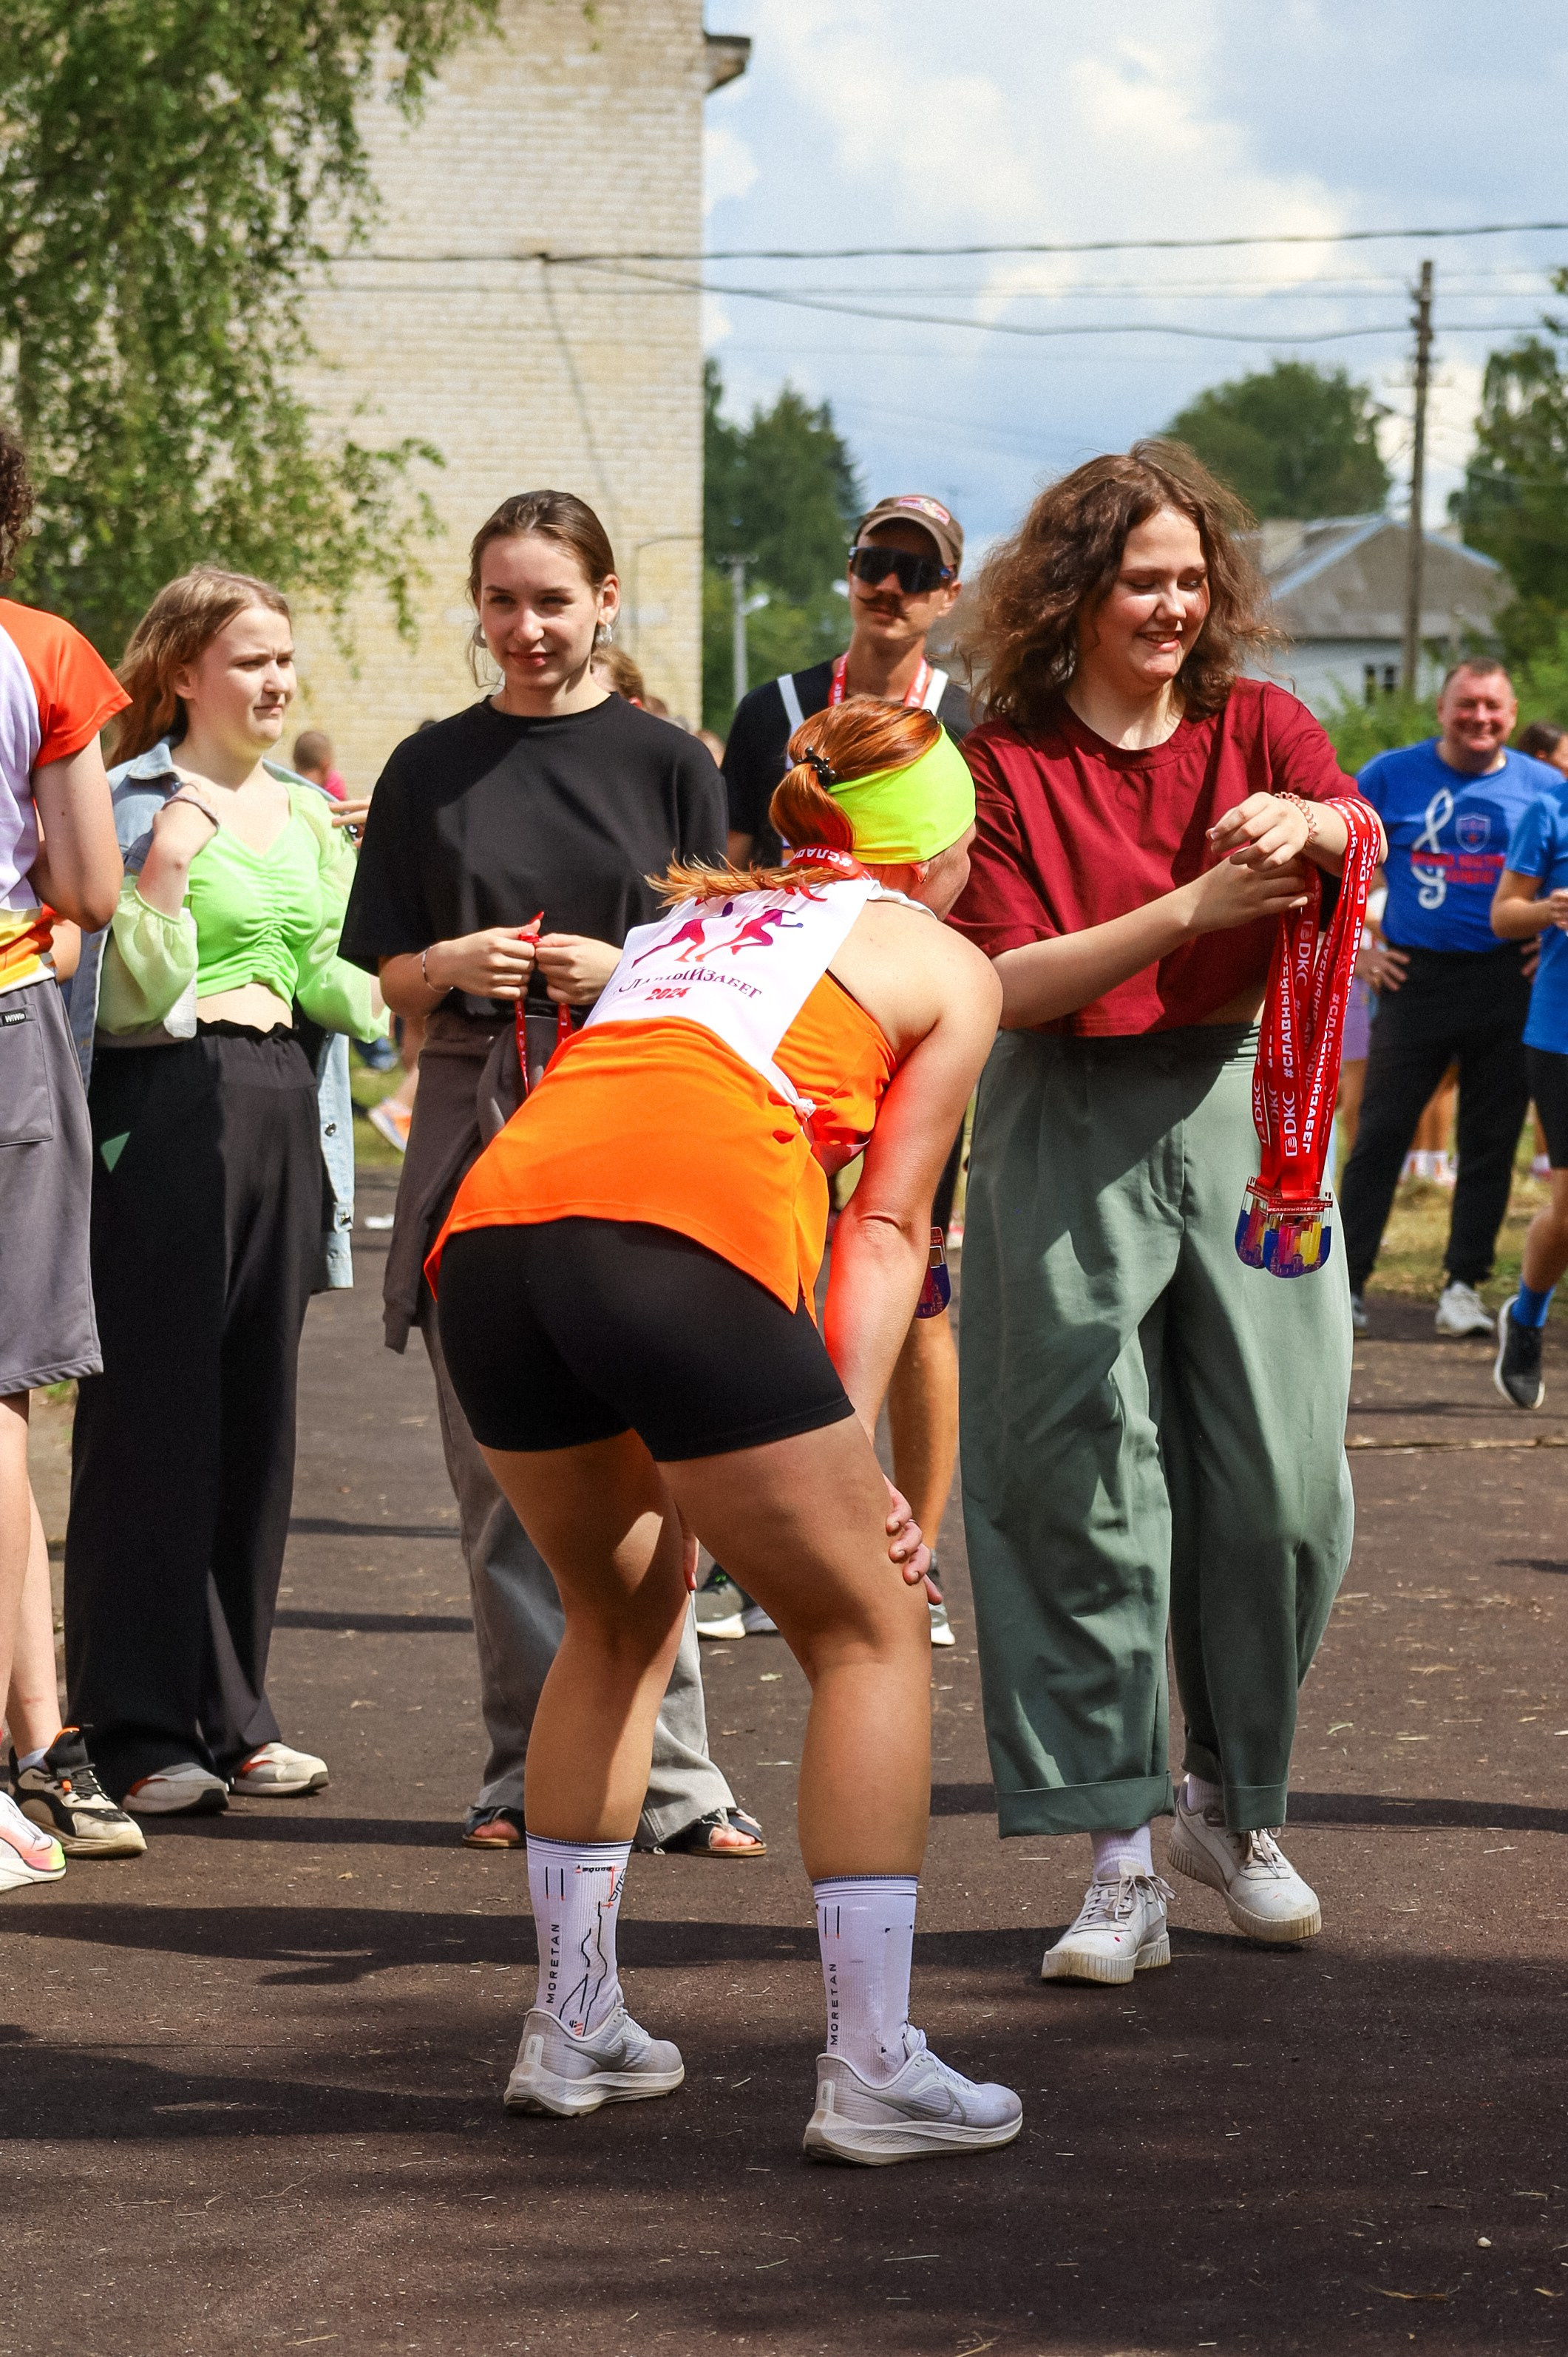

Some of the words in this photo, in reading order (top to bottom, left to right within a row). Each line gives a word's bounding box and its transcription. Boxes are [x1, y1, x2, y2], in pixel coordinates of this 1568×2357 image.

[1359, 837, 1369, 882] DKC
[1294, 942, 1311, 987] DKC
[644, 987, 692, 1001] 2024
[1280, 923, 1294, 1079] #СЛАВНЫЙЗА
[1253, 1078, 1263, 1122] DKC
[1282, 1091, 1297, 1134] DKC
[545, 1924, 560, 2004] MORETAN
[829, 1963, 838, 2046] MORETAN
